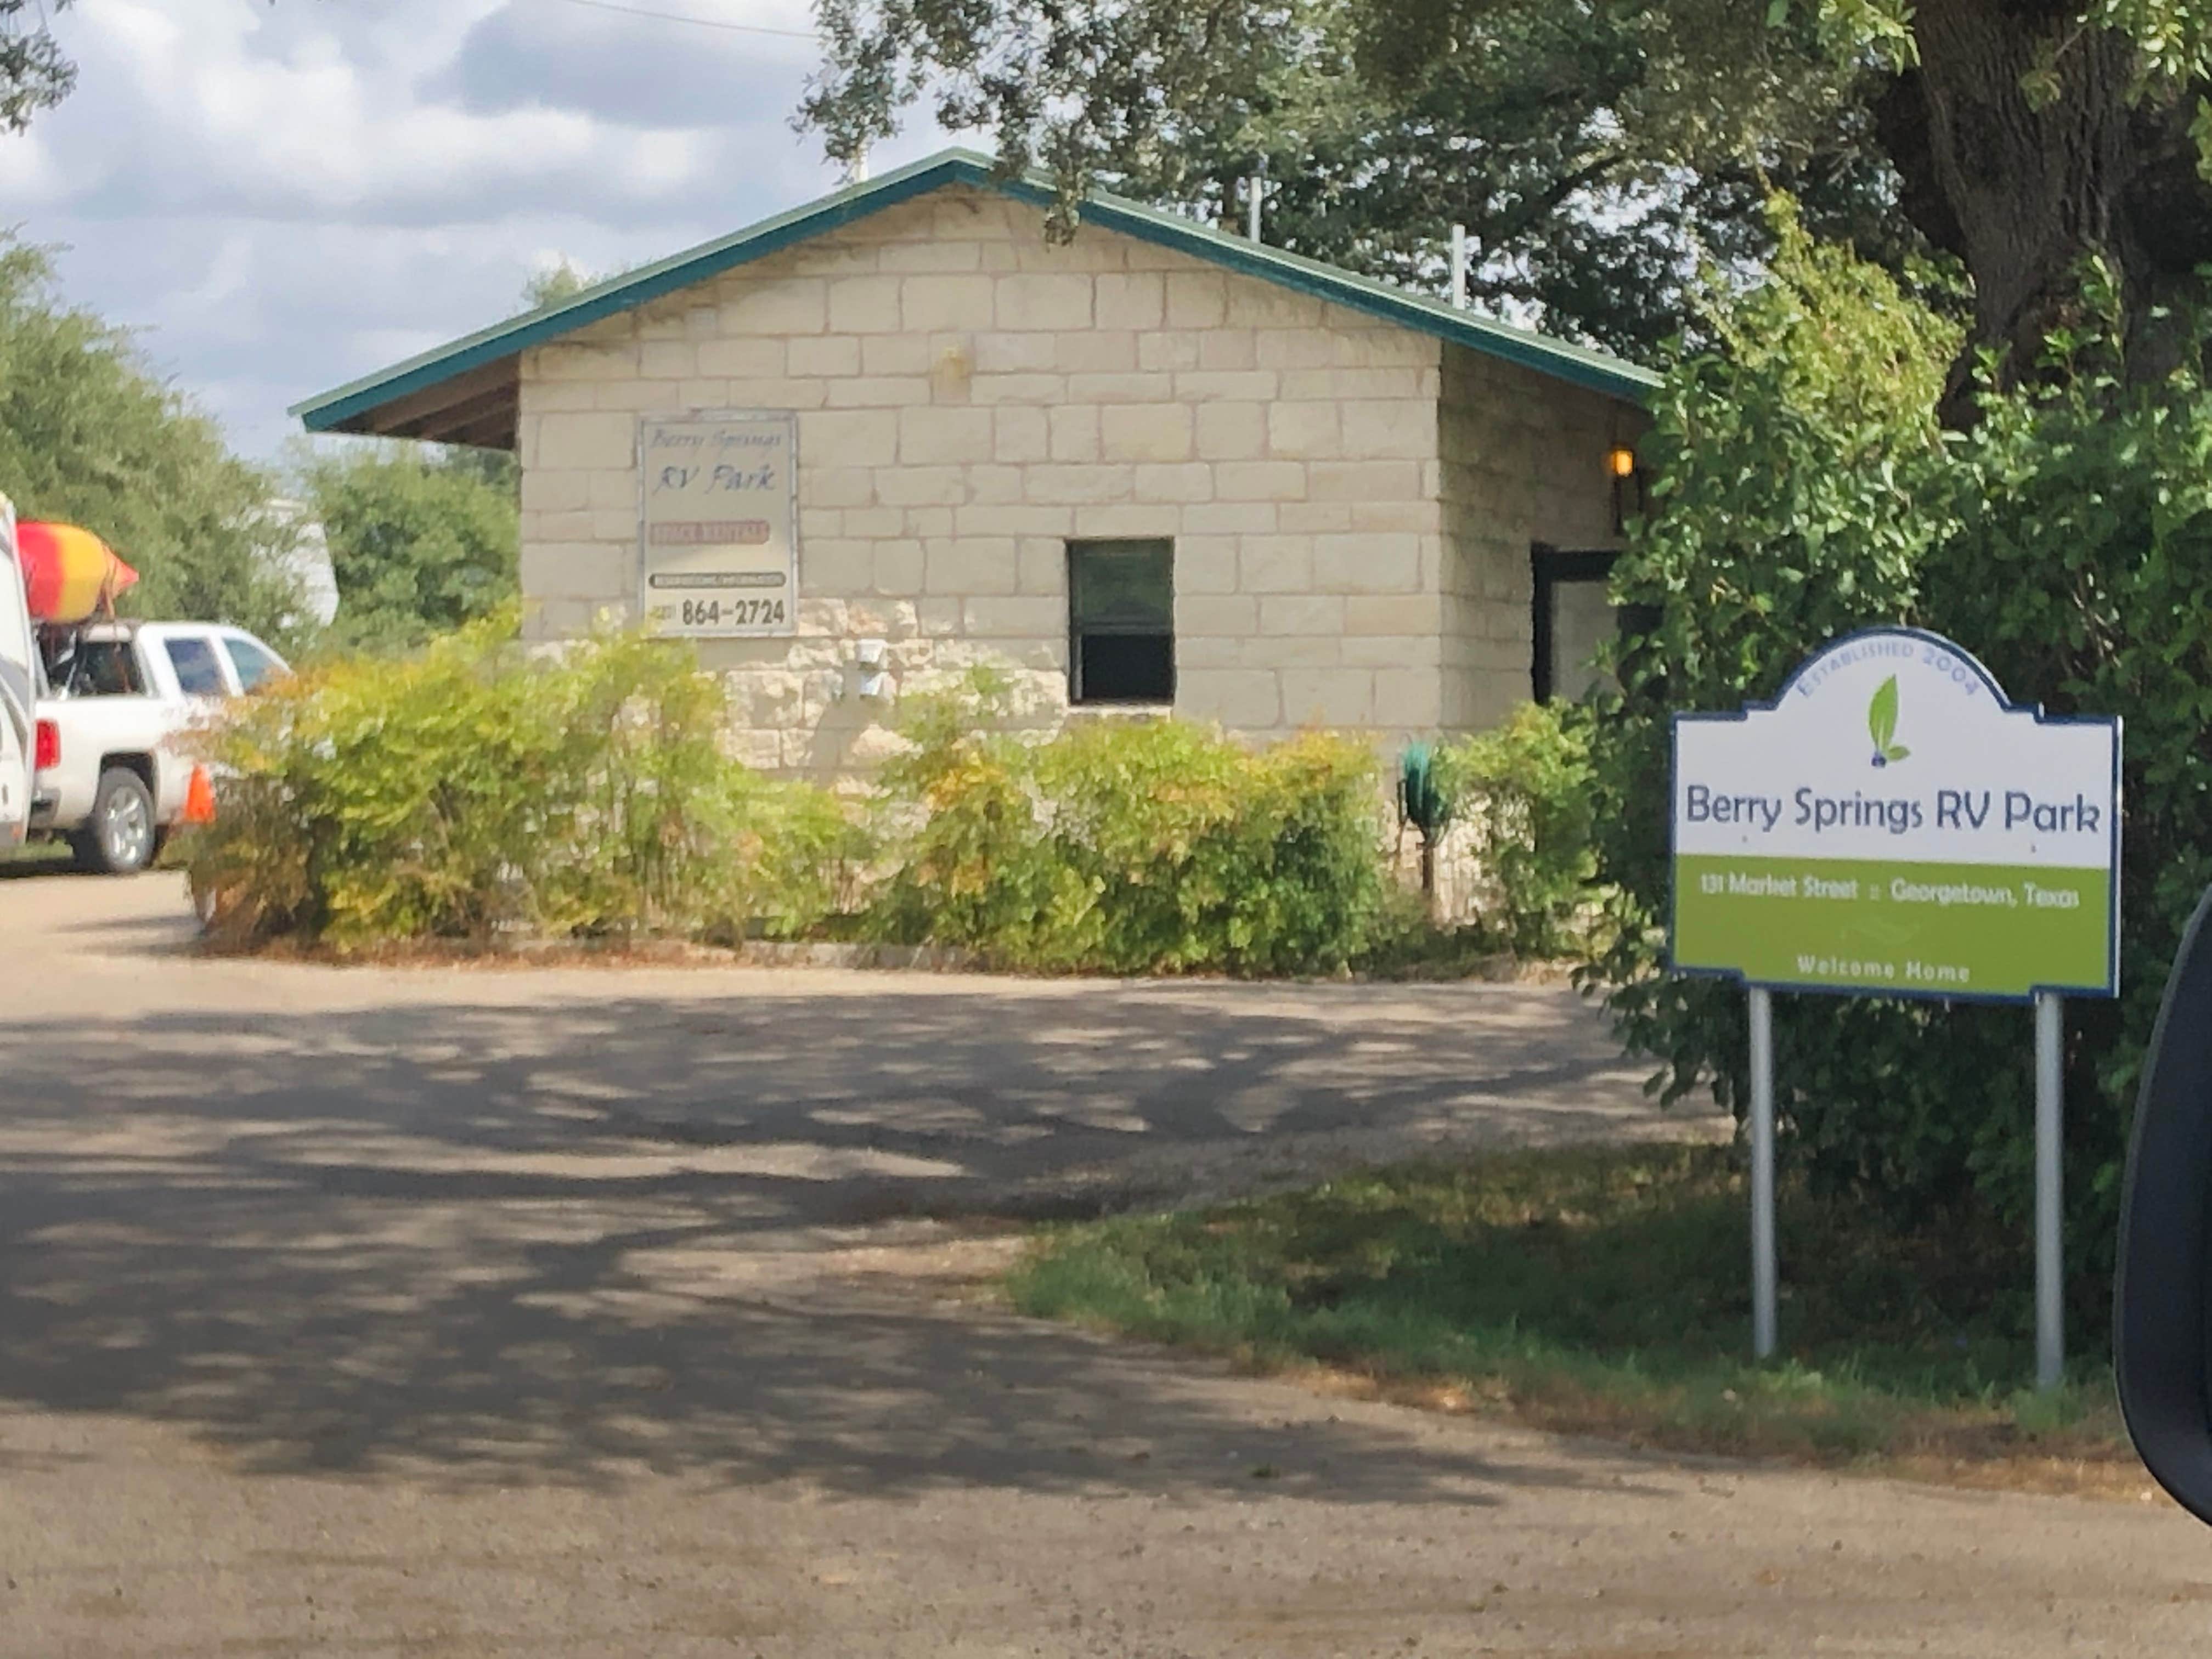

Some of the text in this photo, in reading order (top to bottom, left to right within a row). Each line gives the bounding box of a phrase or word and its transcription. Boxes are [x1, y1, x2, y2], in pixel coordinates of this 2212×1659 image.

[651, 428, 704, 453] Berry
[652, 465, 775, 495] RV Park
[682, 599, 785, 625] 864-2724
[1797, 640, 1914, 698] ESTABLISHED
[1688, 785, 2100, 835] Berry Springs RV Park
[1730, 872, 1797, 897] Market
[1803, 874, 1858, 900] Street
[1891, 877, 2018, 908] Georgetown,
[2024, 881, 2080, 907] Texas
[1797, 953, 1970, 983] Welcome Home
